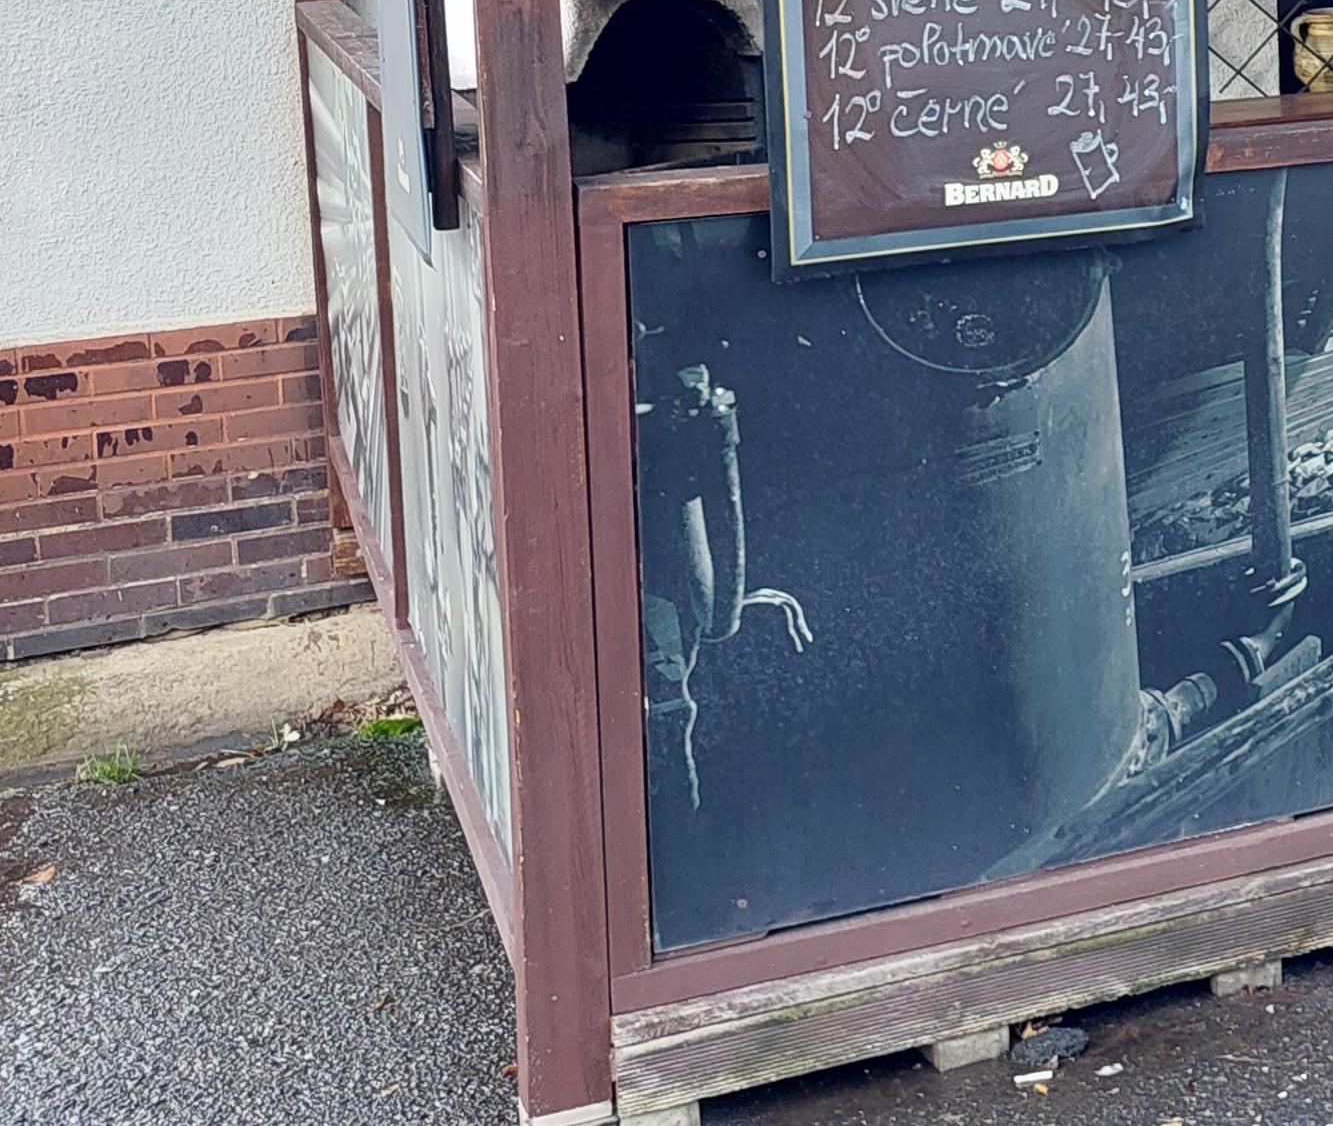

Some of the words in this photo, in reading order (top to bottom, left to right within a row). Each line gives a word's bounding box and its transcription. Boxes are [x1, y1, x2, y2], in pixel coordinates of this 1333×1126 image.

[819, 26, 871, 79] 12°
[878, 20, 1070, 89] polotmavé
[822, 89, 881, 150] 12°
[890, 80, 1026, 137] černé
[943, 174, 1059, 206] BERNARD
